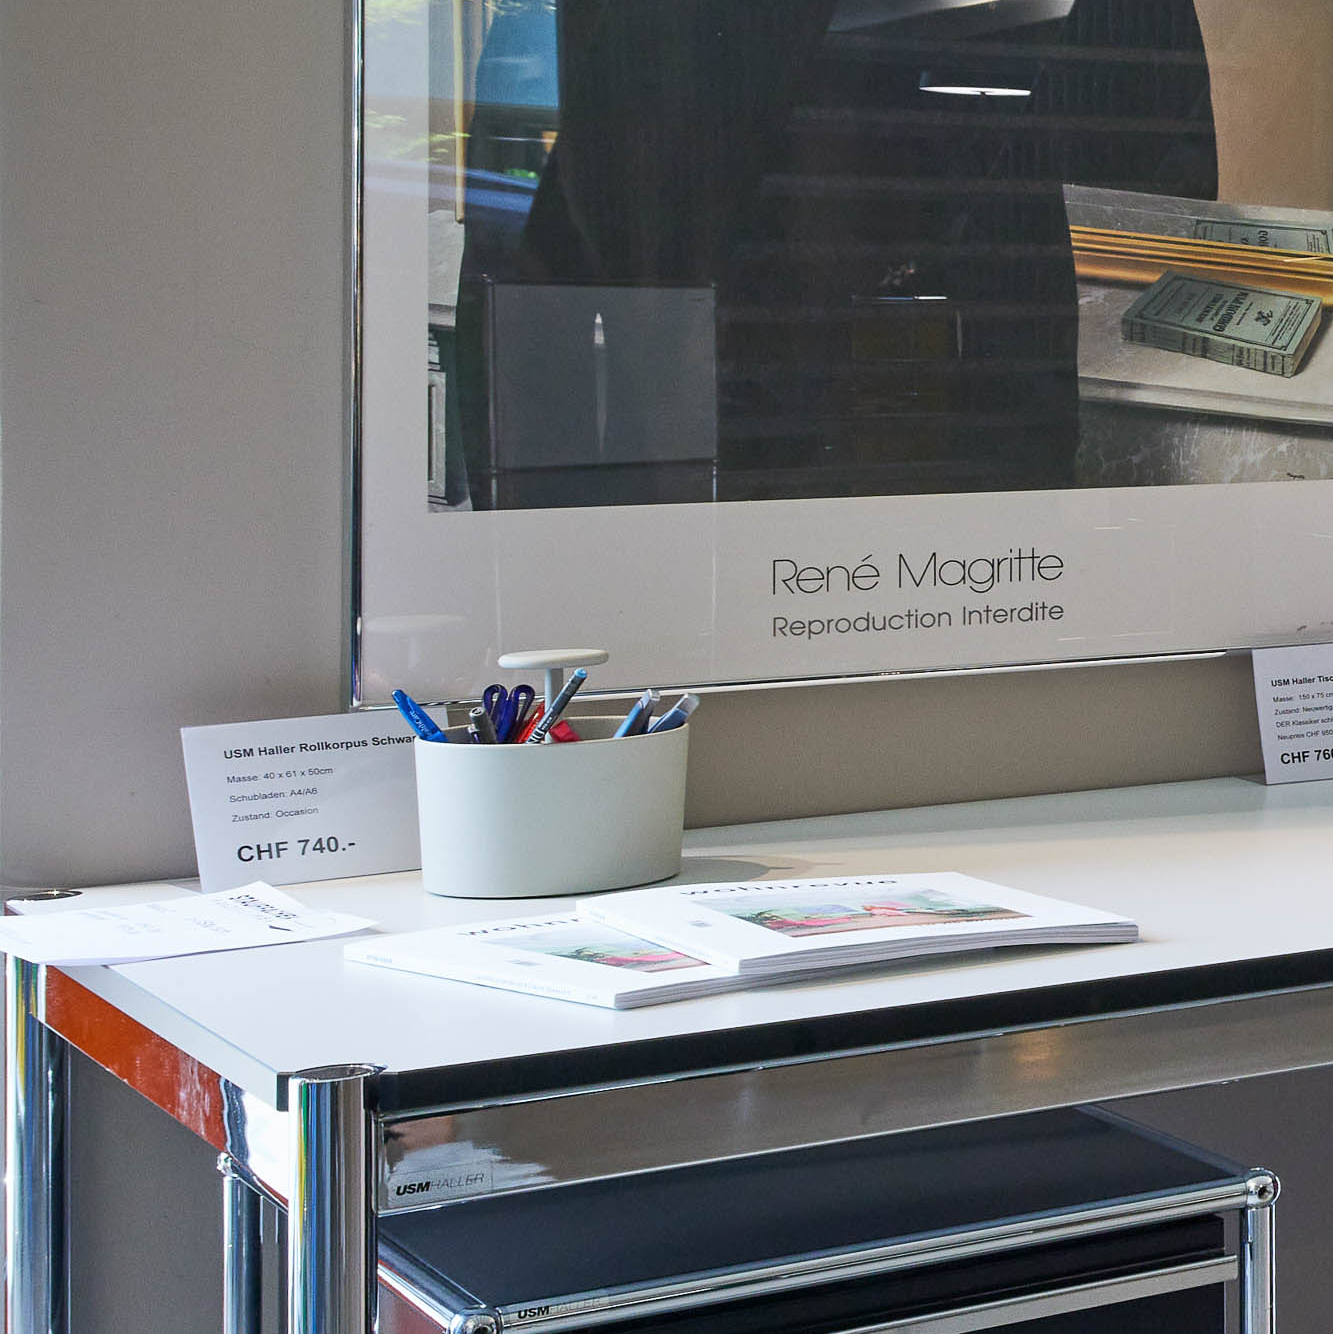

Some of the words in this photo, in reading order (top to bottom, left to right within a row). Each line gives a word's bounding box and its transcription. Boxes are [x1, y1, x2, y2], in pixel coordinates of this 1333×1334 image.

[772, 553, 881, 595] René
[898, 547, 1064, 594] Magritte
[772, 609, 952, 640] Reproduction
[962, 601, 1064, 627] Interdite
[1271, 678, 1290, 687] USM
[1292, 676, 1316, 685] Haller
[223, 747, 255, 760] USM
[258, 744, 296, 757] Haller
[299, 739, 369, 753] Rollkorpus
[1280, 750, 1310, 765] CHF
[226, 774, 260, 784] Masse:
[263, 771, 276, 780] 40
[285, 769, 297, 778] 61
[307, 766, 334, 776] 50cm
[229, 790, 288, 803] Schubladen:
[231, 811, 273, 823] Zustand:
[275, 806, 320, 819] Occasion
[237, 841, 289, 863] CHF
[297, 835, 356, 857] 740.-
